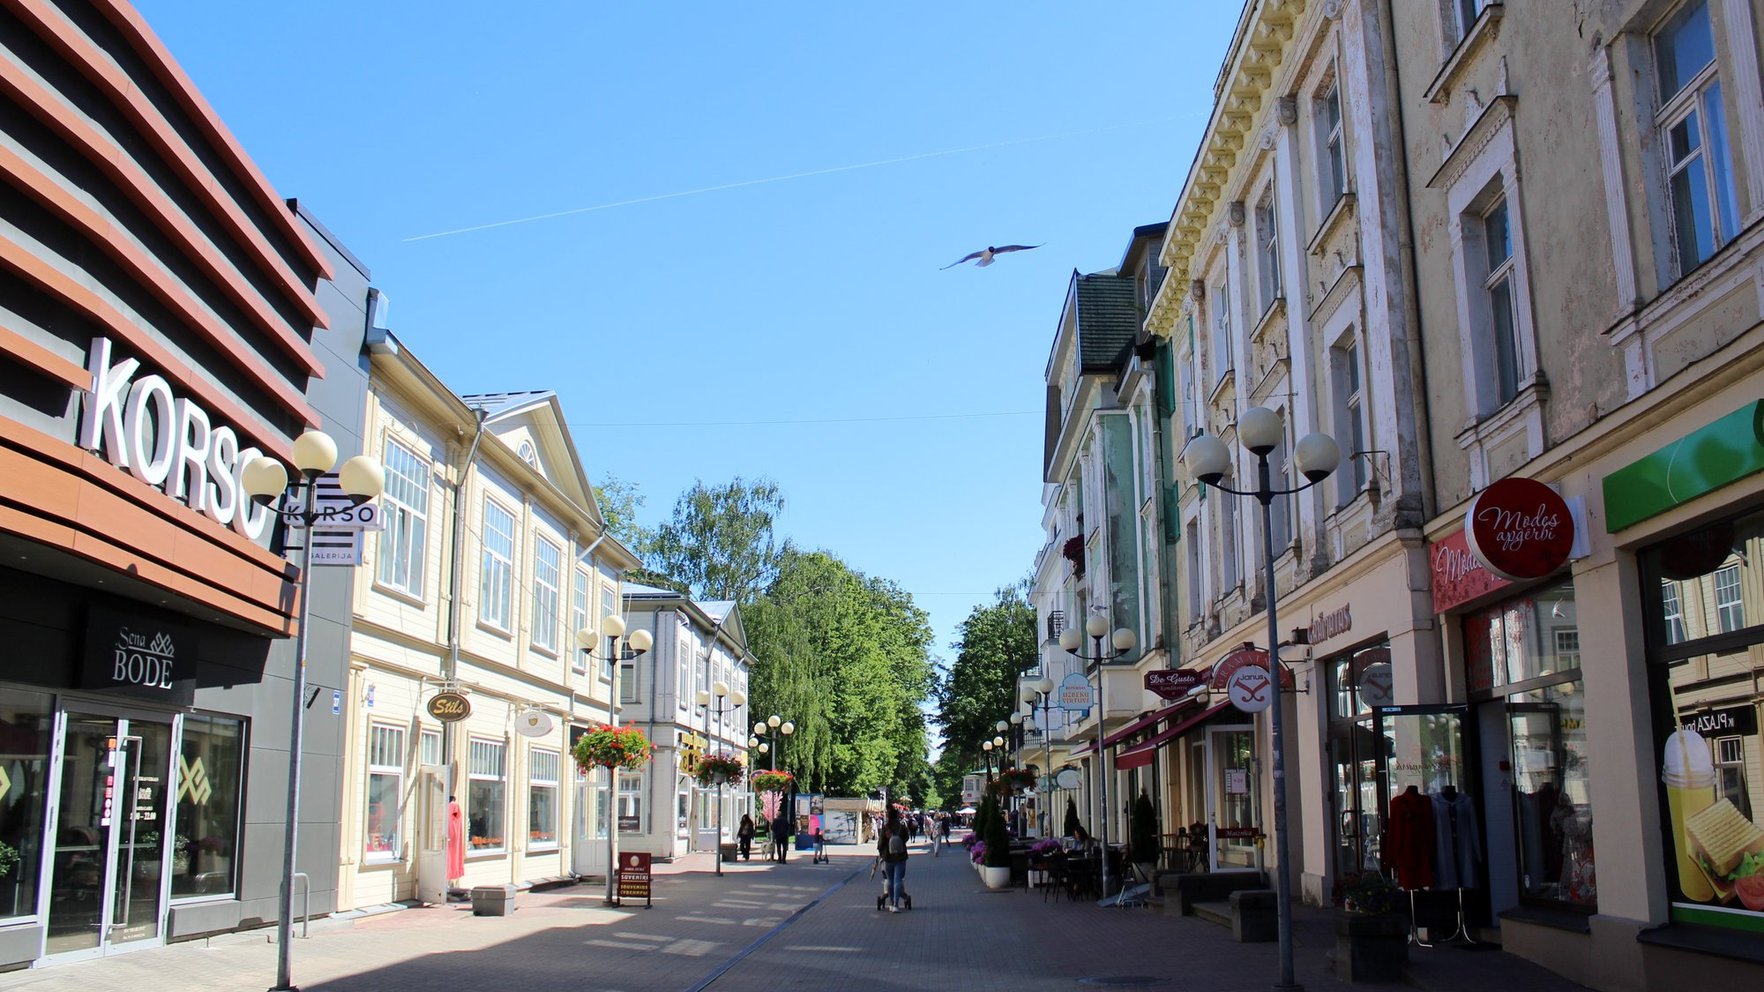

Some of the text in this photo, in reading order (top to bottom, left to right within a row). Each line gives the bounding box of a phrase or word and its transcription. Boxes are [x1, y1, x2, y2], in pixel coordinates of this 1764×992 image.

[79, 336, 268, 540] KORSO
[286, 505, 374, 523] KRSO
[1478, 503, 1561, 530] Modes
[115, 626, 146, 649] Sena
[112, 649, 173, 690] BODE
[1149, 672, 1195, 685] De Gusto
[433, 699, 464, 714] Stils
